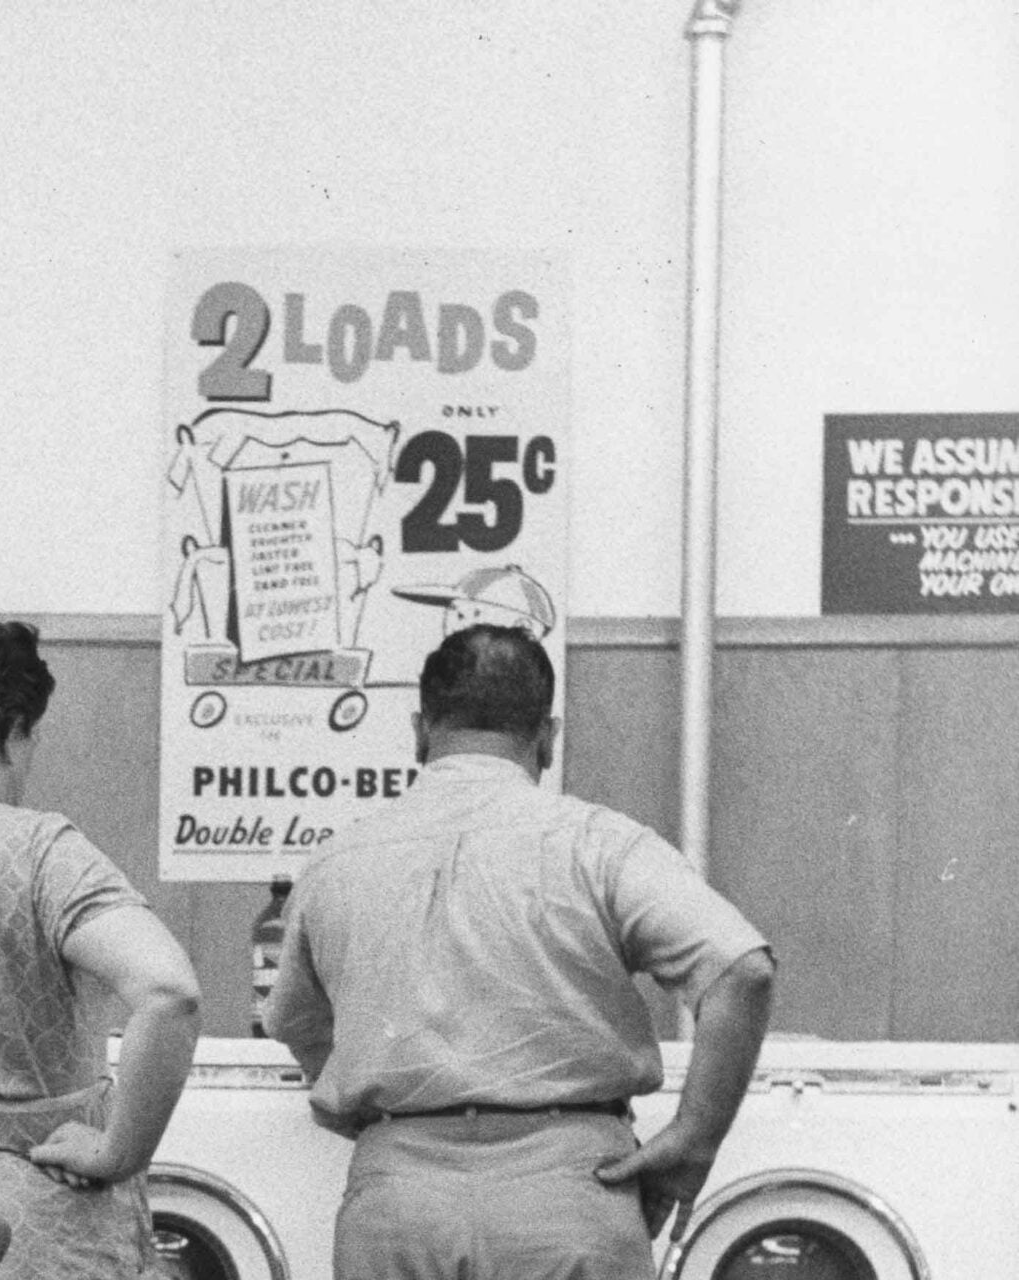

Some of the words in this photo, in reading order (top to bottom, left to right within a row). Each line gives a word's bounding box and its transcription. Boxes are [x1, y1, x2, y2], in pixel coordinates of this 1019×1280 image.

[190, 281, 272, 402] 2
[283, 290, 540, 384] LOADS
[441, 404, 501, 419] ONLY
[845, 437, 905, 477] WE
[237, 480, 321, 515] WASH
[249, 521, 308, 534] CLEANER
[920, 571, 984, 597] YOUR
[212, 655, 336, 682] SPECIAL
[175, 814, 275, 846] Double
